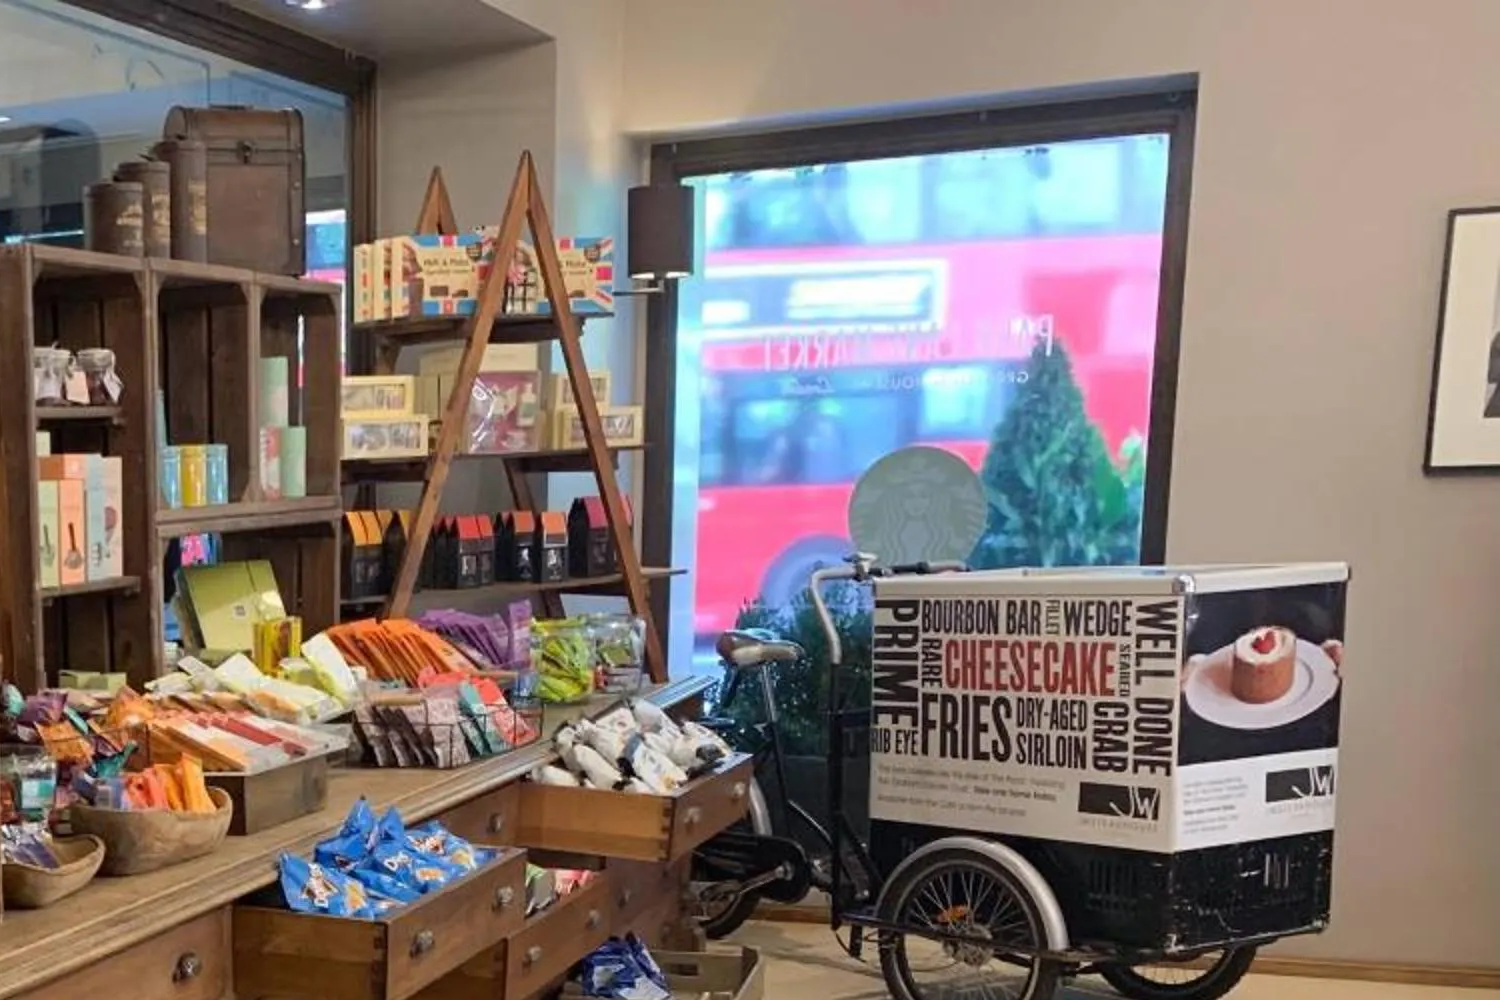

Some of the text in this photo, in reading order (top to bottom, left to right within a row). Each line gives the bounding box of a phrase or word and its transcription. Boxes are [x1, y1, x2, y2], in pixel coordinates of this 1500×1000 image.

[921, 599, 1042, 636] BOURBON BAR
[1063, 600, 1133, 638] WEDGE
[873, 599, 921, 727] PRIME
[921, 638, 943, 689] RARE
[944, 639, 1116, 697] CHEESECAKE
[1015, 696, 1088, 732] DRY-AGED
[1131, 600, 1179, 778] WELL DONE
[871, 727, 919, 756] RIB EYE
[921, 692, 1013, 763] FRIES
[1015, 732, 1088, 770] SIRLOIN
[1092, 700, 1130, 773] CRAB
